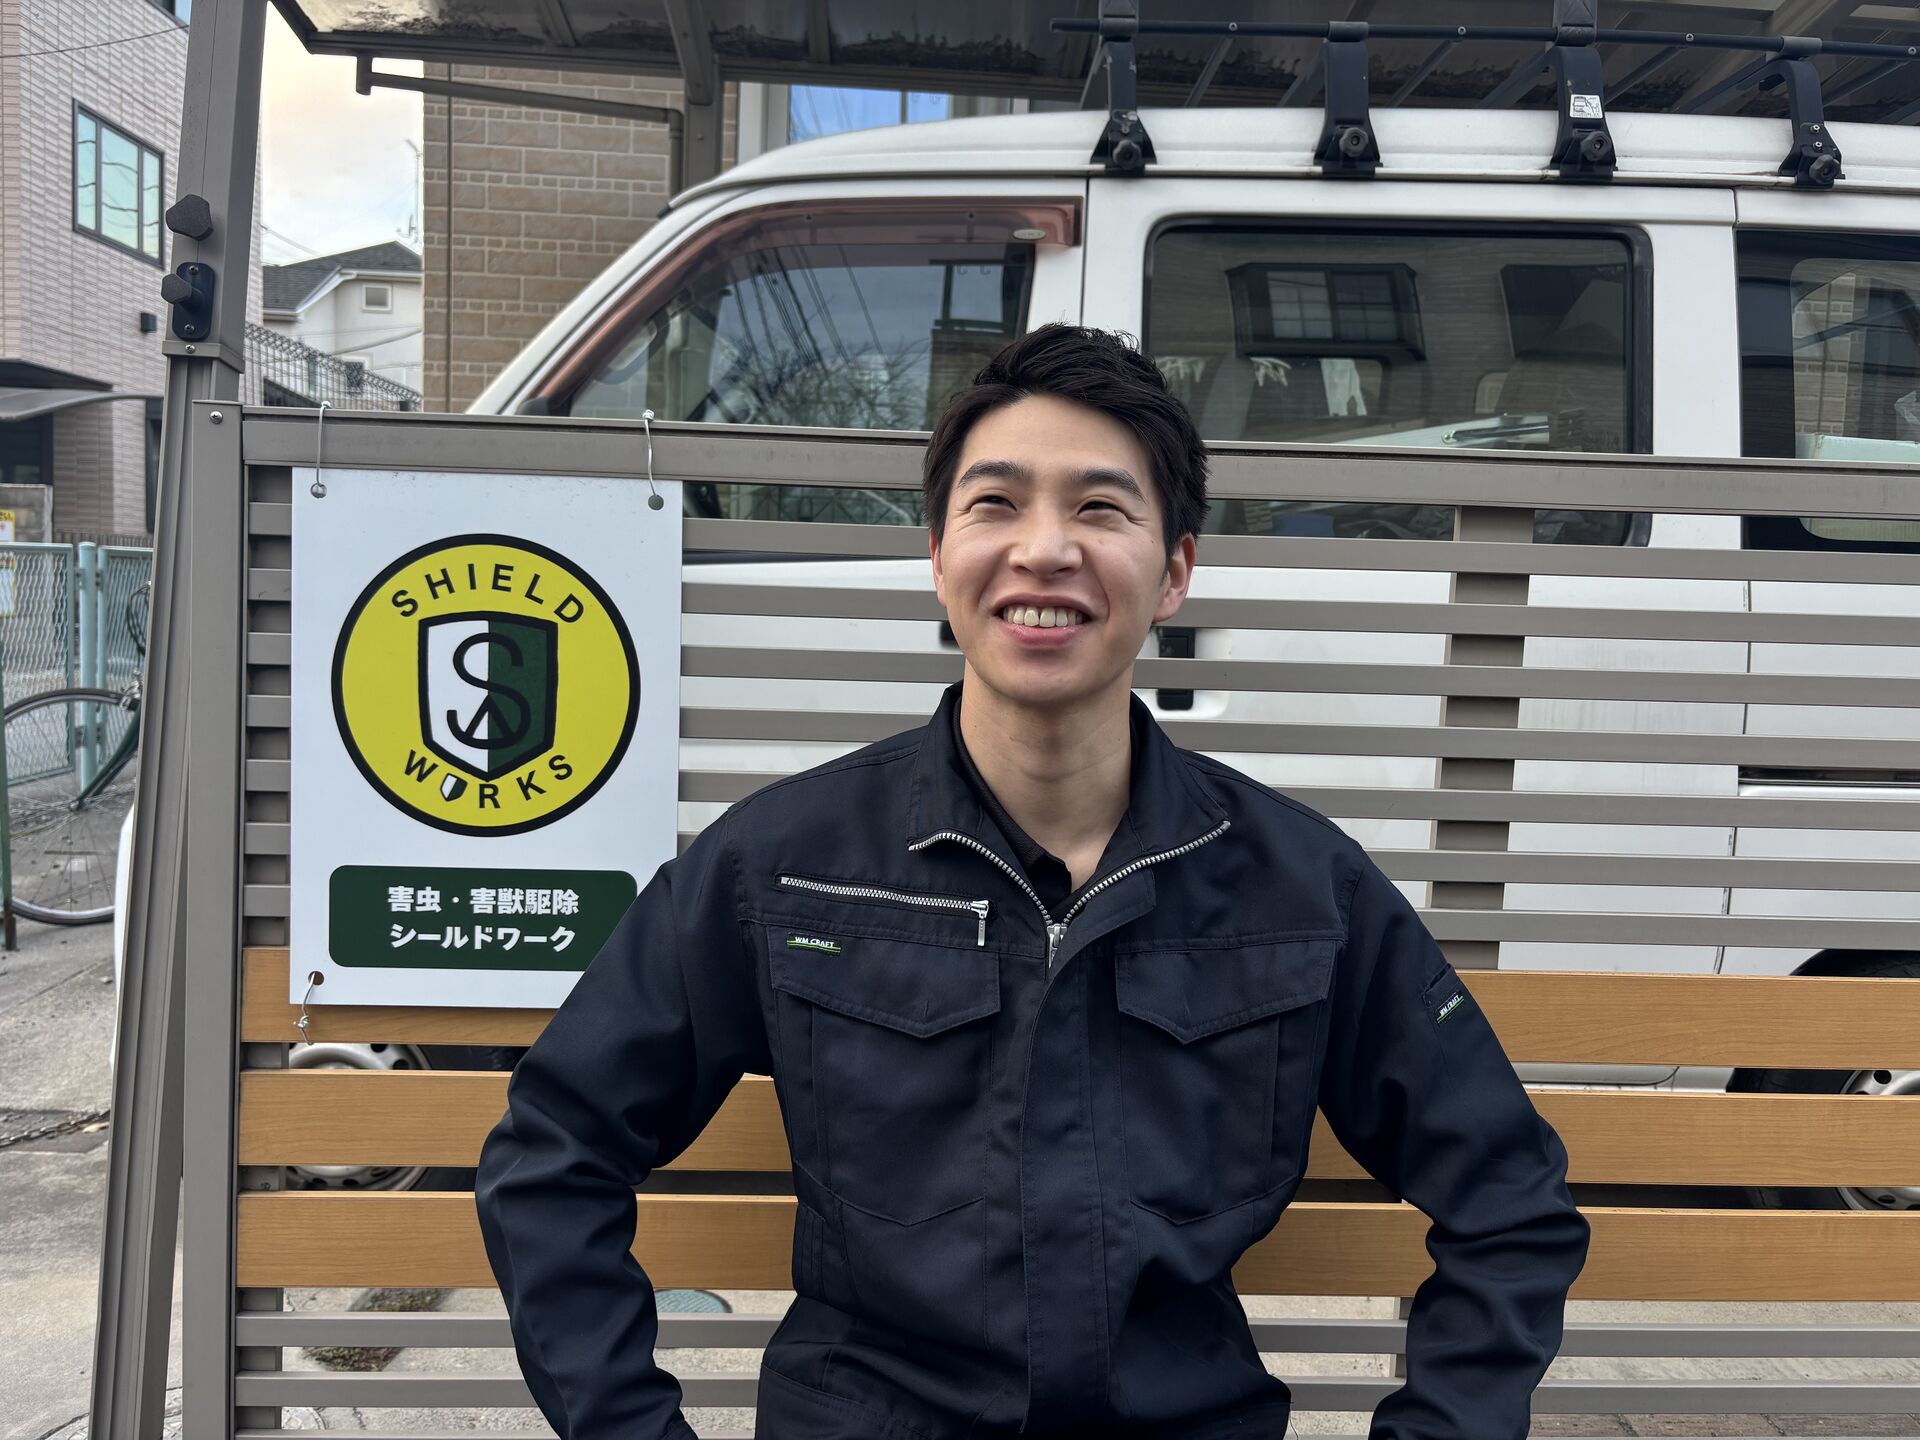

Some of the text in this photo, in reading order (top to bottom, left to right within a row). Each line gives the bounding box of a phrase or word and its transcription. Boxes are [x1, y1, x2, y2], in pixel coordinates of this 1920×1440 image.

[391, 563, 584, 623] SHIELD
[387, 885, 580, 915] 害虫・害獣駆除
[390, 923, 576, 953] シールドワーク
[811, 938, 834, 948] CRAFT
